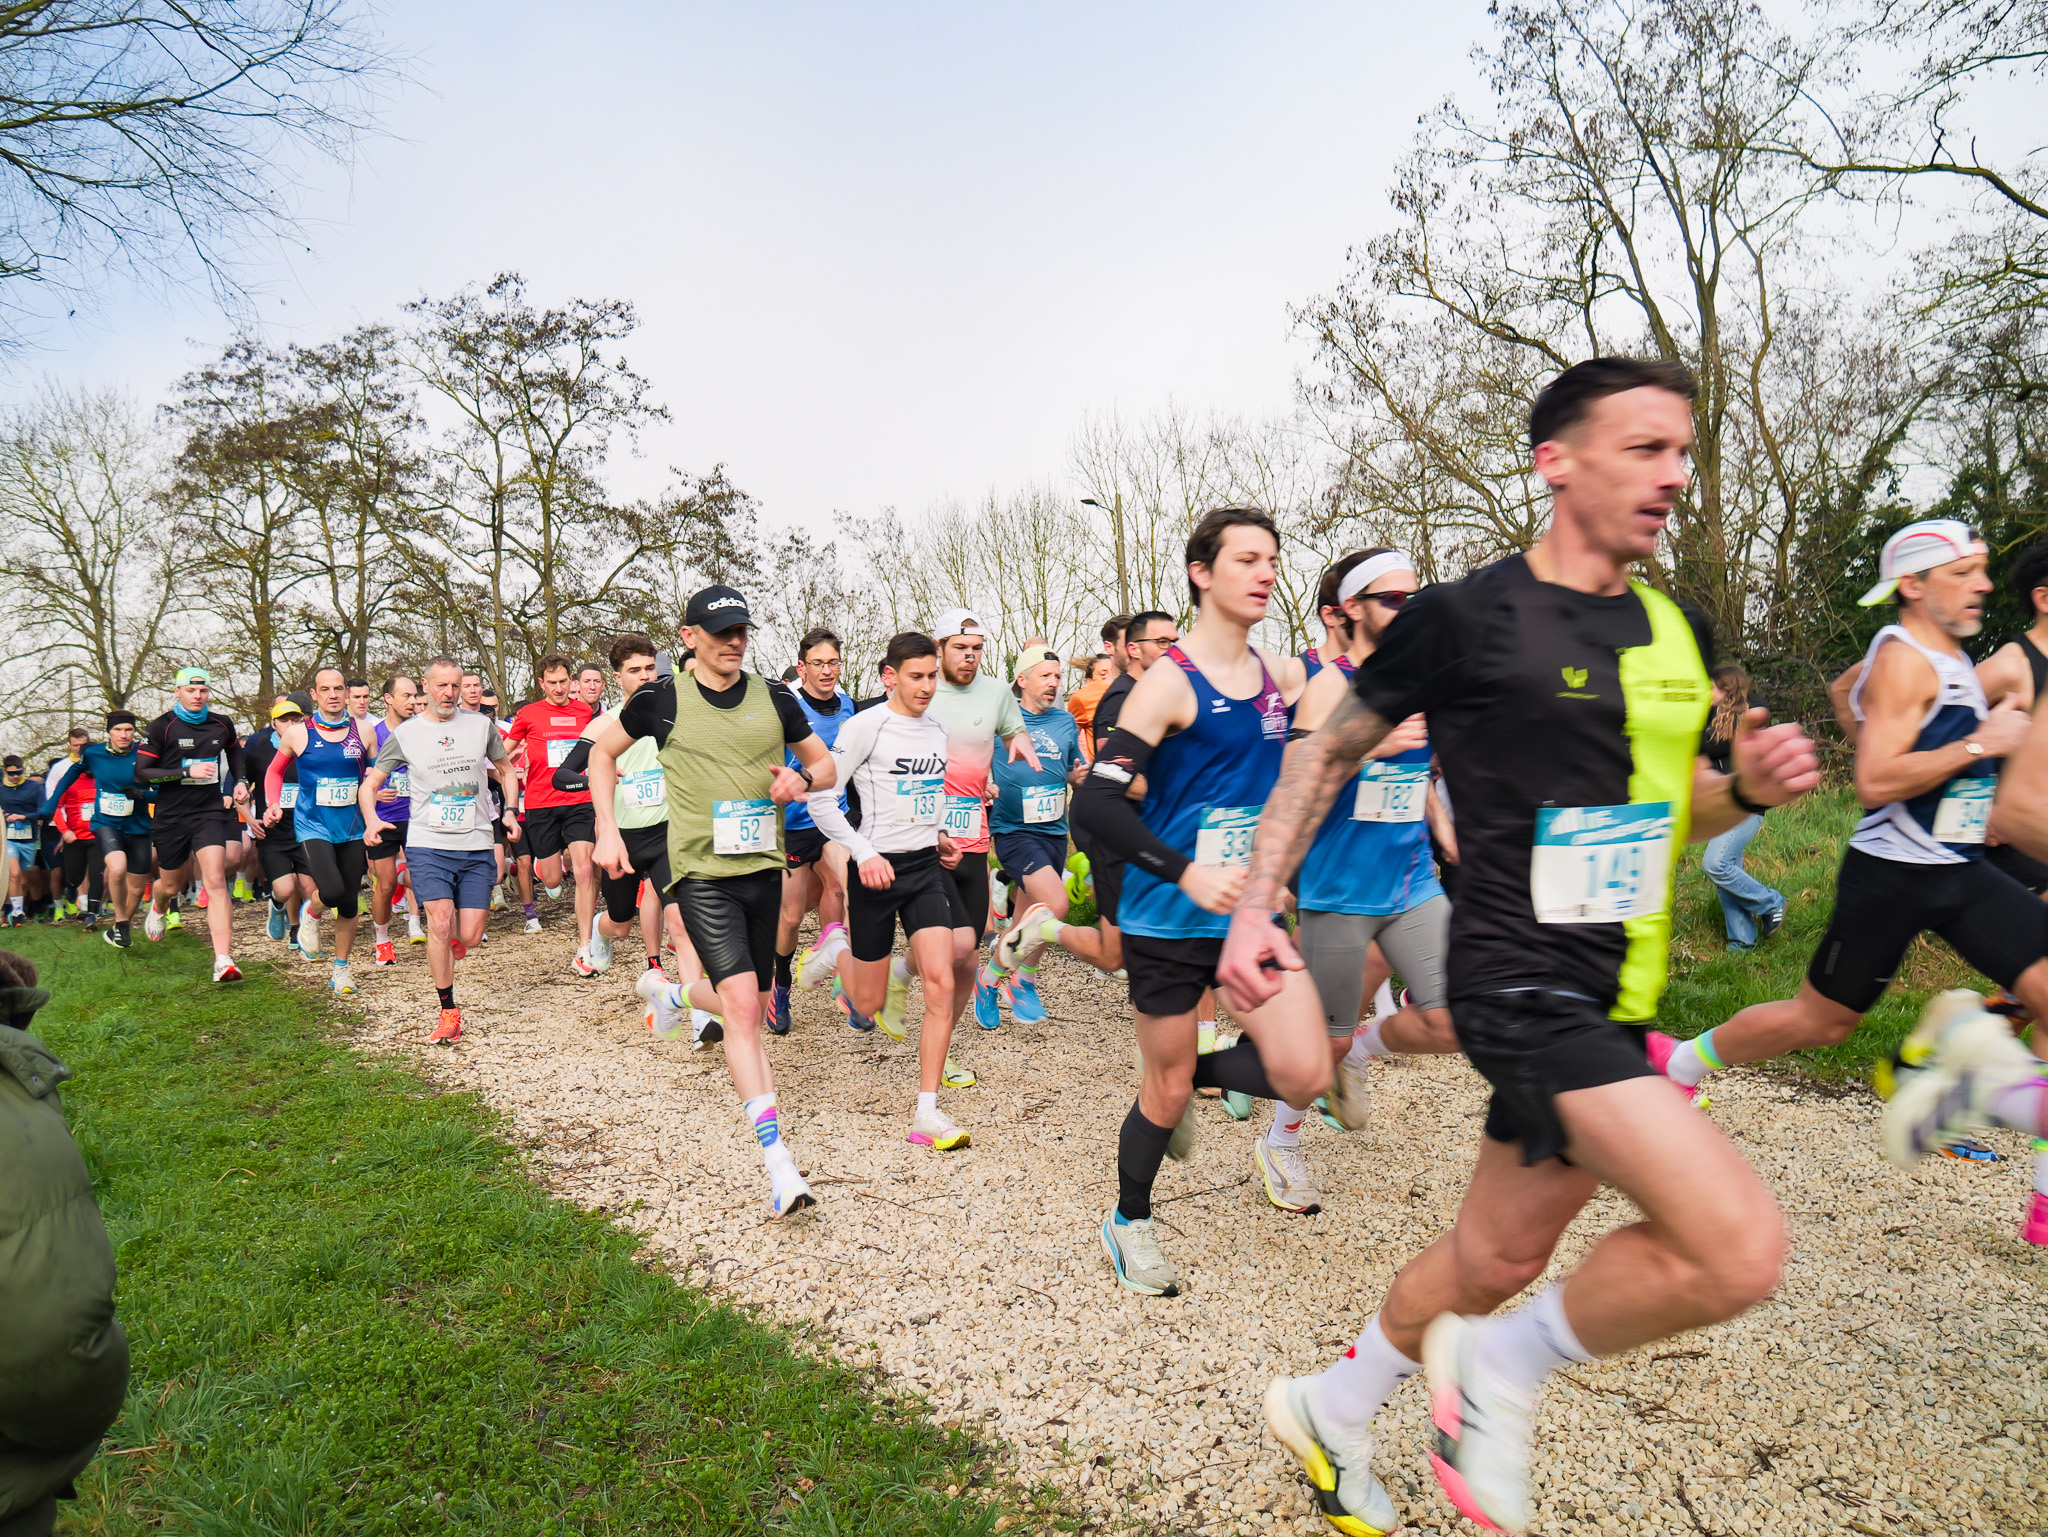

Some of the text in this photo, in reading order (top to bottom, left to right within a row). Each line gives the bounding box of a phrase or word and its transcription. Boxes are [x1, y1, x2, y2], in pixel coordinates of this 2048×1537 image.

[707, 597, 746, 611] adidas
[400, 781, 410, 791] 28
[636, 782, 659, 799] 367
[280, 792, 292, 802] 98
[330, 788, 348, 800] 143
[108, 801, 125, 812] 466
[913, 795, 935, 815] 133
[1037, 797, 1058, 814] 441
[442, 807, 465, 821] 352
[944, 811, 970, 829] 400
[740, 818, 760, 841] 52
[1222, 830, 1253, 858] 33
